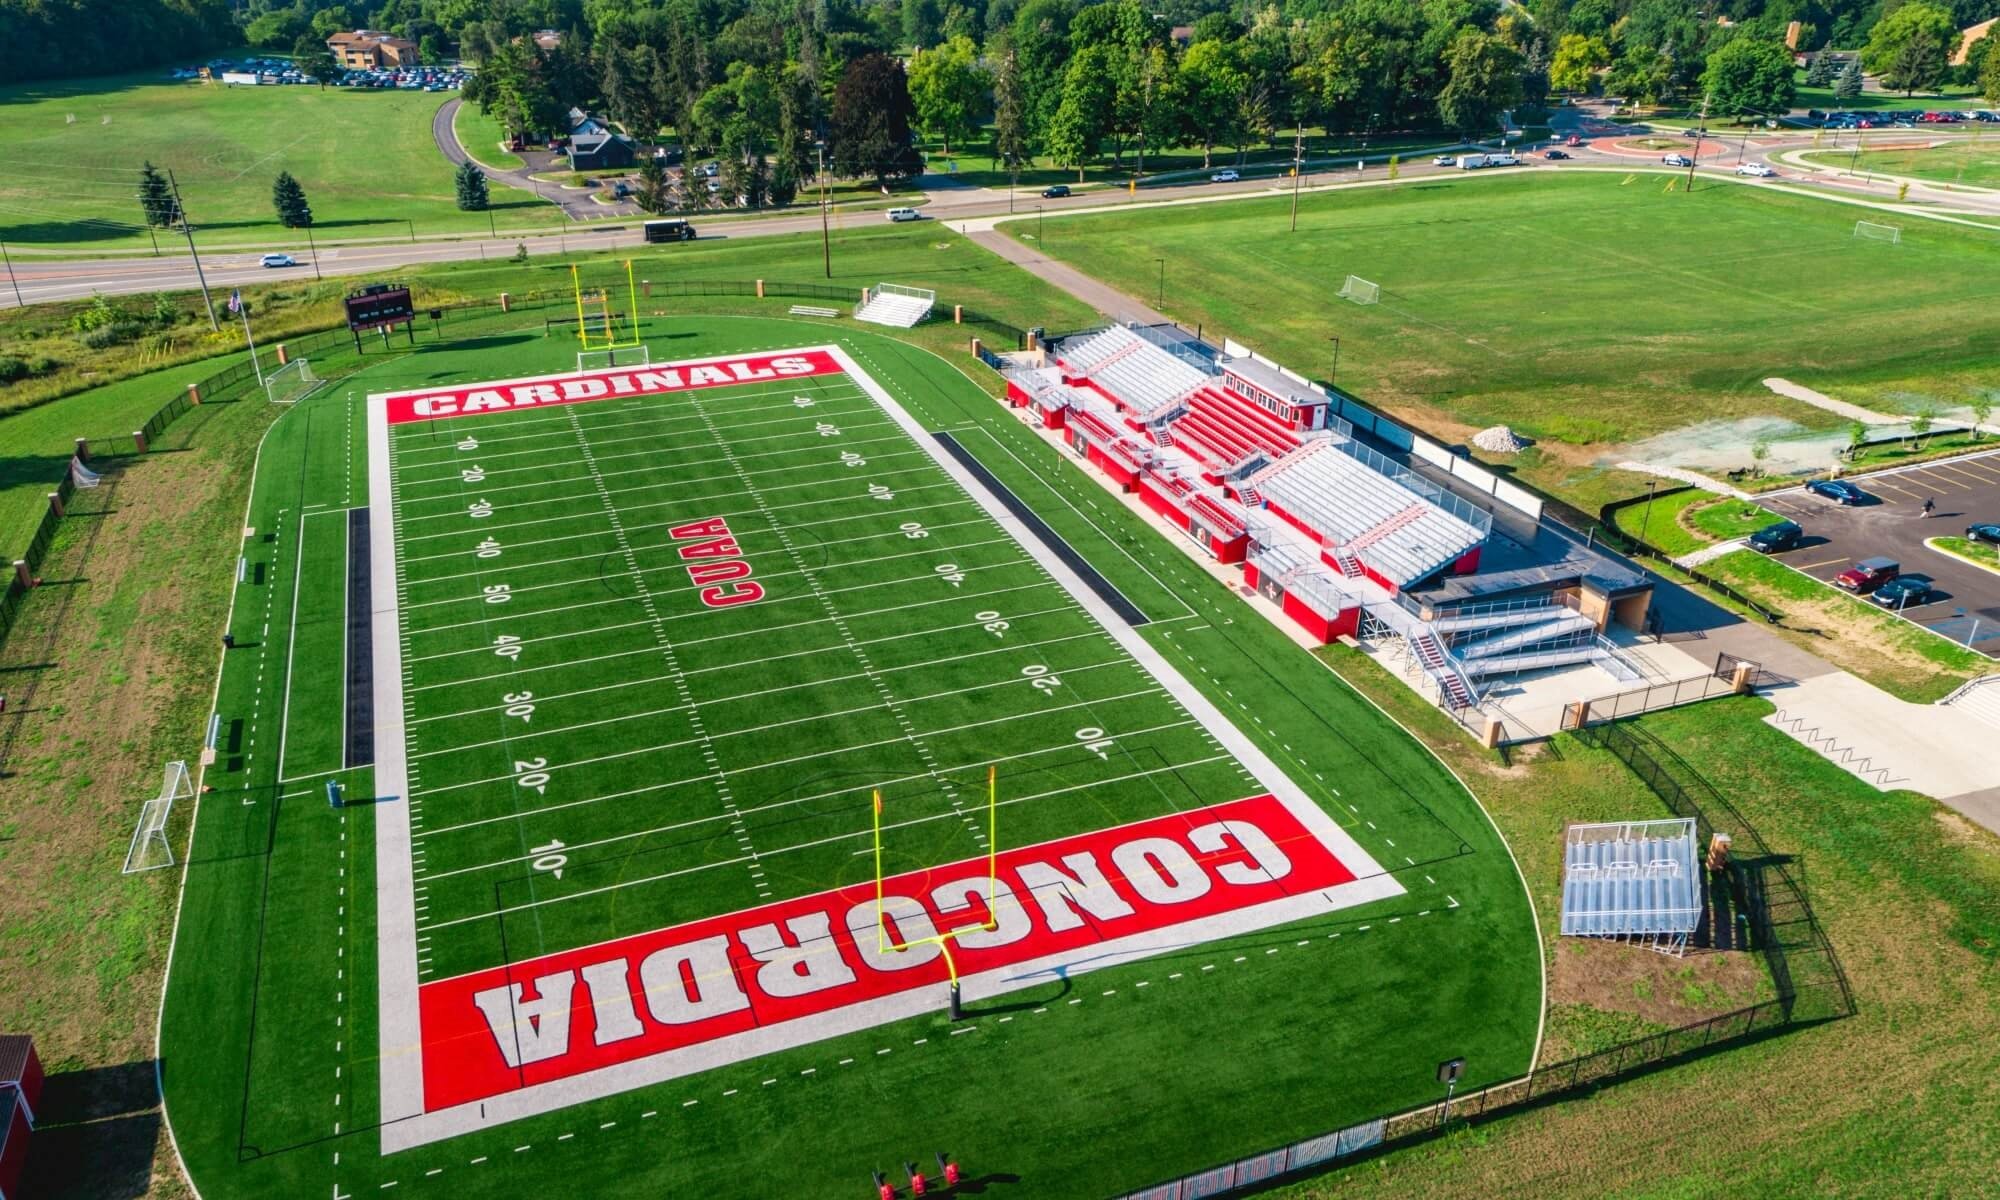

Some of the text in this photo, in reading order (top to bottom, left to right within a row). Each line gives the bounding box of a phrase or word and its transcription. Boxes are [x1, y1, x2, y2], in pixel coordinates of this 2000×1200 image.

[413, 357, 815, 417] CARDINALS
[457, 439, 478, 451] 10
[841, 453, 866, 467] 30
[462, 467, 485, 482] 20
[868, 485, 895, 500] 40
[469, 502, 493, 518] 30
[900, 522, 929, 539] 50
[476, 541, 502, 558] 40
[668, 516, 766, 608] CUAA
[935, 563, 965, 582] 40
[483, 584, 512, 604] 50
[975, 611, 1010, 632] 30
[493, 635, 523, 656] 40
[1021, 664, 1061, 689] 20
[503, 691, 535, 717] 30
[1075, 727, 1114, 753] 10
[514, 757, 550, 787] 20
[530, 839, 568, 871] 10
[473, 820, 1292, 1069] CONCORDIA
